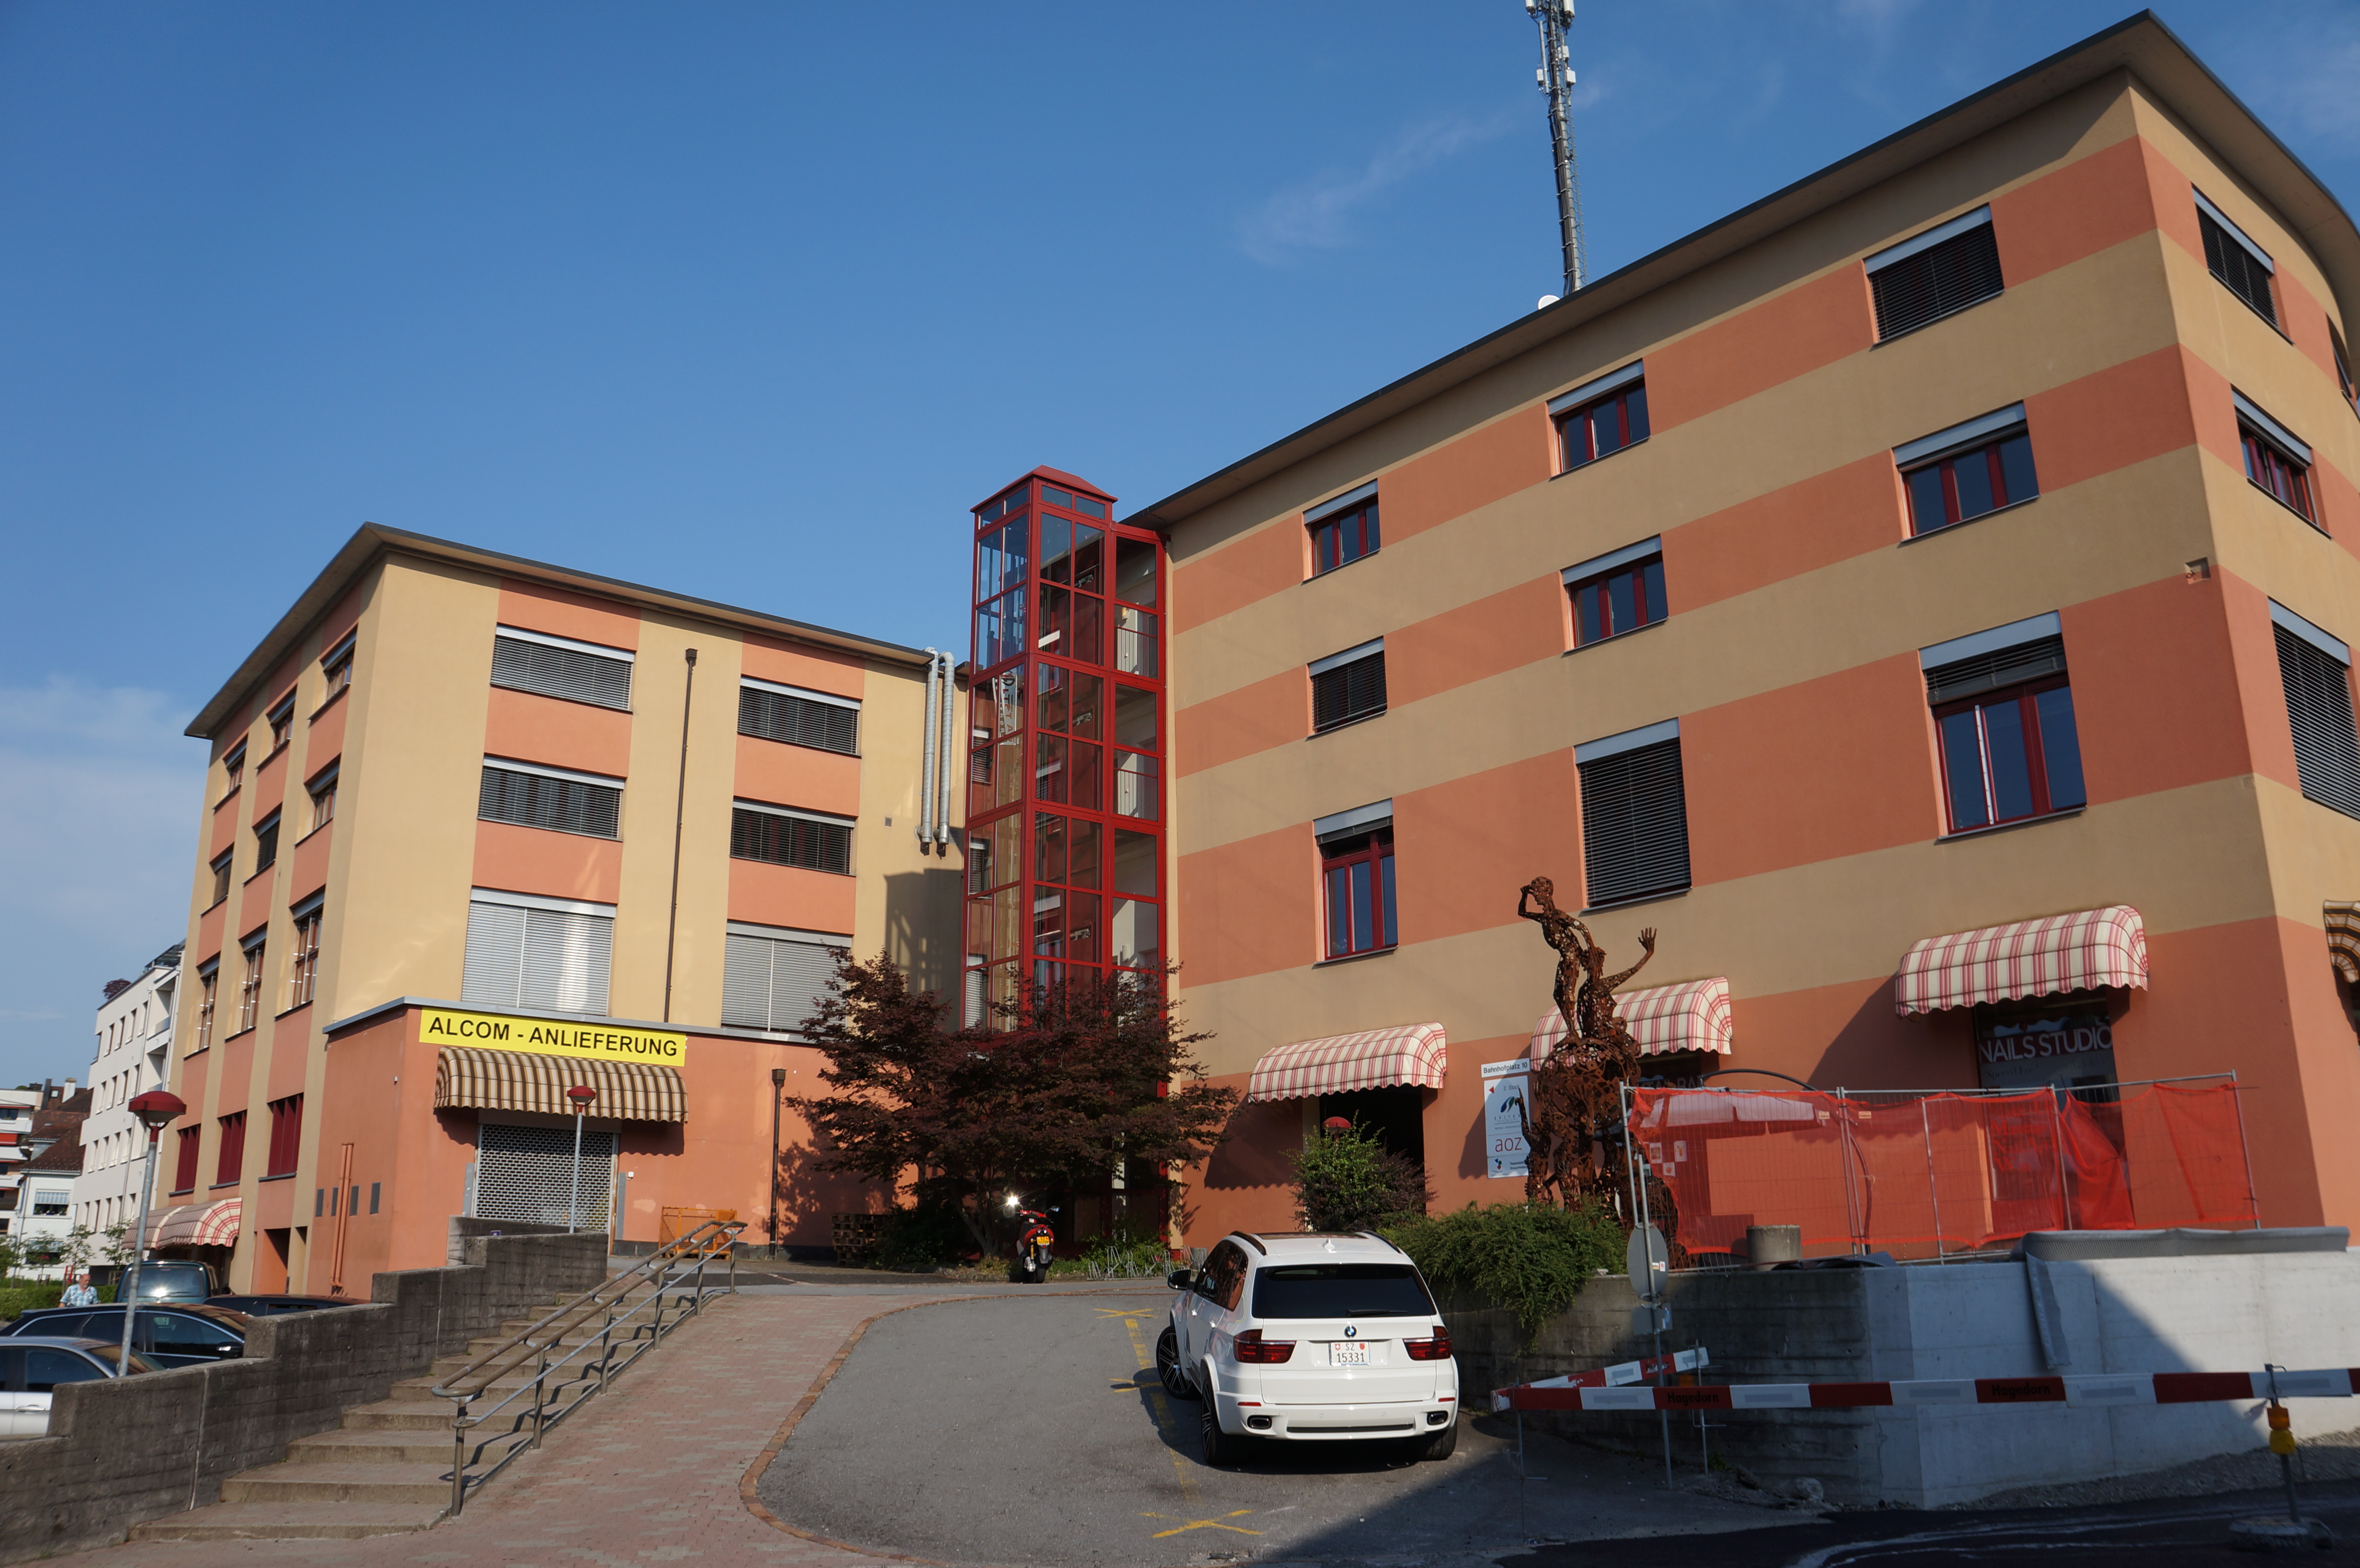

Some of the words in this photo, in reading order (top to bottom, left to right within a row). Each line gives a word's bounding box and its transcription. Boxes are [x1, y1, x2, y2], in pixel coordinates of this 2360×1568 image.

[428, 1017, 510, 1041] ALCOM
[529, 1027, 677, 1056] ANLIEFERUNG
[1979, 1036, 2036, 1063] NAILS
[2038, 1025, 2113, 1056] STUDIO
[1483, 1063, 1520, 1074] Bahnhofplatz
[1495, 1137, 1522, 1152] aoz
[1337, 1352, 1365, 1362] 15331
